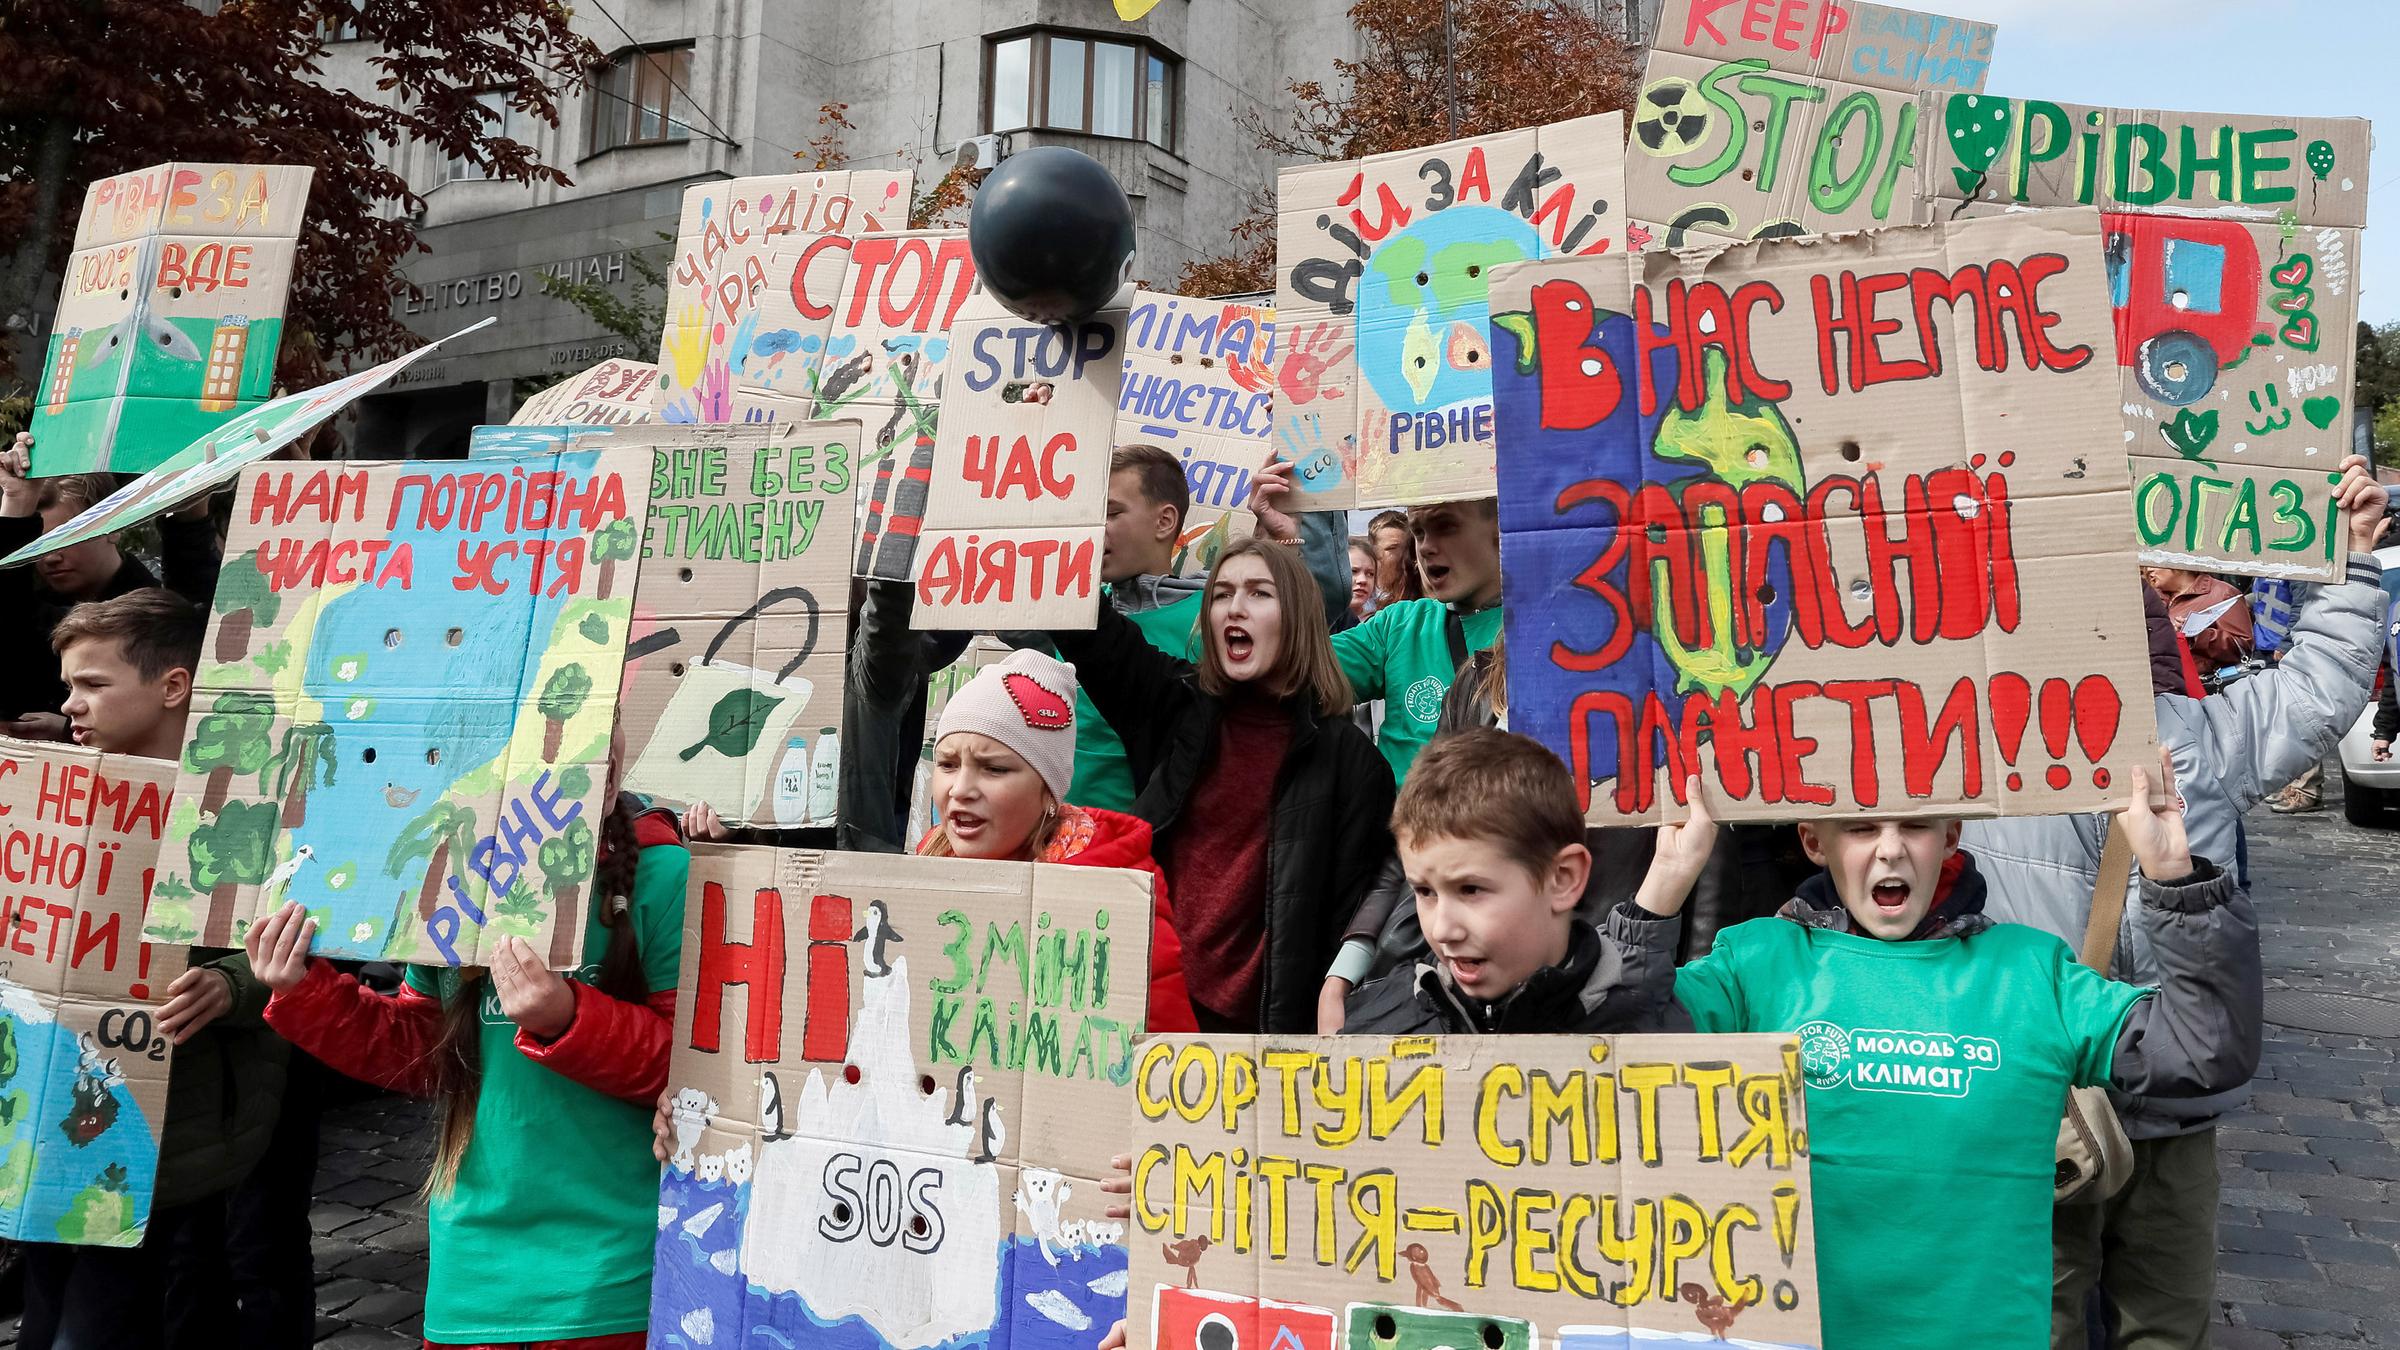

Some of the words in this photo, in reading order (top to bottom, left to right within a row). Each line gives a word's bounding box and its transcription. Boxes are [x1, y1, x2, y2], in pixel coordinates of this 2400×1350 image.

[1684, 0, 1849, 60] KEEP
[2009, 99, 2298, 205] РІВНЕ
[87, 169, 202, 241] РІВНЕ
[203, 168, 269, 228] ЗА
[1290, 172, 1412, 315] ДІЙ
[1419, 146, 1492, 212] ЗА
[74, 245, 137, 297] 100%
[157, 242, 254, 293] ВДЕ
[676, 199, 751, 289] ЧАС
[964, 320, 1116, 393] STOP
[1532, 278, 1624, 430] В
[1632, 277, 1793, 416] НАС
[1811, 253, 2094, 396] НЕМАЄ
[1389, 404, 1492, 454] РІВНЕ
[249, 469, 369, 526] НАМ
[385, 466, 627, 534] ПОТРІБНА
[750, 442, 851, 498] БЕЗ
[962, 432, 1078, 502] ЧАС
[255, 537, 414, 593] ЧИСТА
[451, 536, 586, 600] УСТЯ
[918, 535, 1095, 607] ДІЯТИ
[1551, 451, 2021, 672] ЗАПАСНОЇ
[36, 761, 175, 839] НЕМА
[0, 829, 122, 897] СНОЇ
[427, 768, 584, 968] РІВНЕ
[689, 880, 853, 1064] НІ
[929, 908, 1111, 1012] ЗМІНІ
[1801, 1025, 1823, 1038] FOR
[1824, 1026, 1851, 1060] FUTURE
[1816, 1071, 1842, 1086] RIVNE
[1857, 1036, 1955, 1058] МОЛОДЬ
[1134, 1036, 1446, 1147] СОРТУЙ
[1472, 1041, 1810, 1172] СМІТТЯ!
[818, 1152, 945, 1255] SOS
